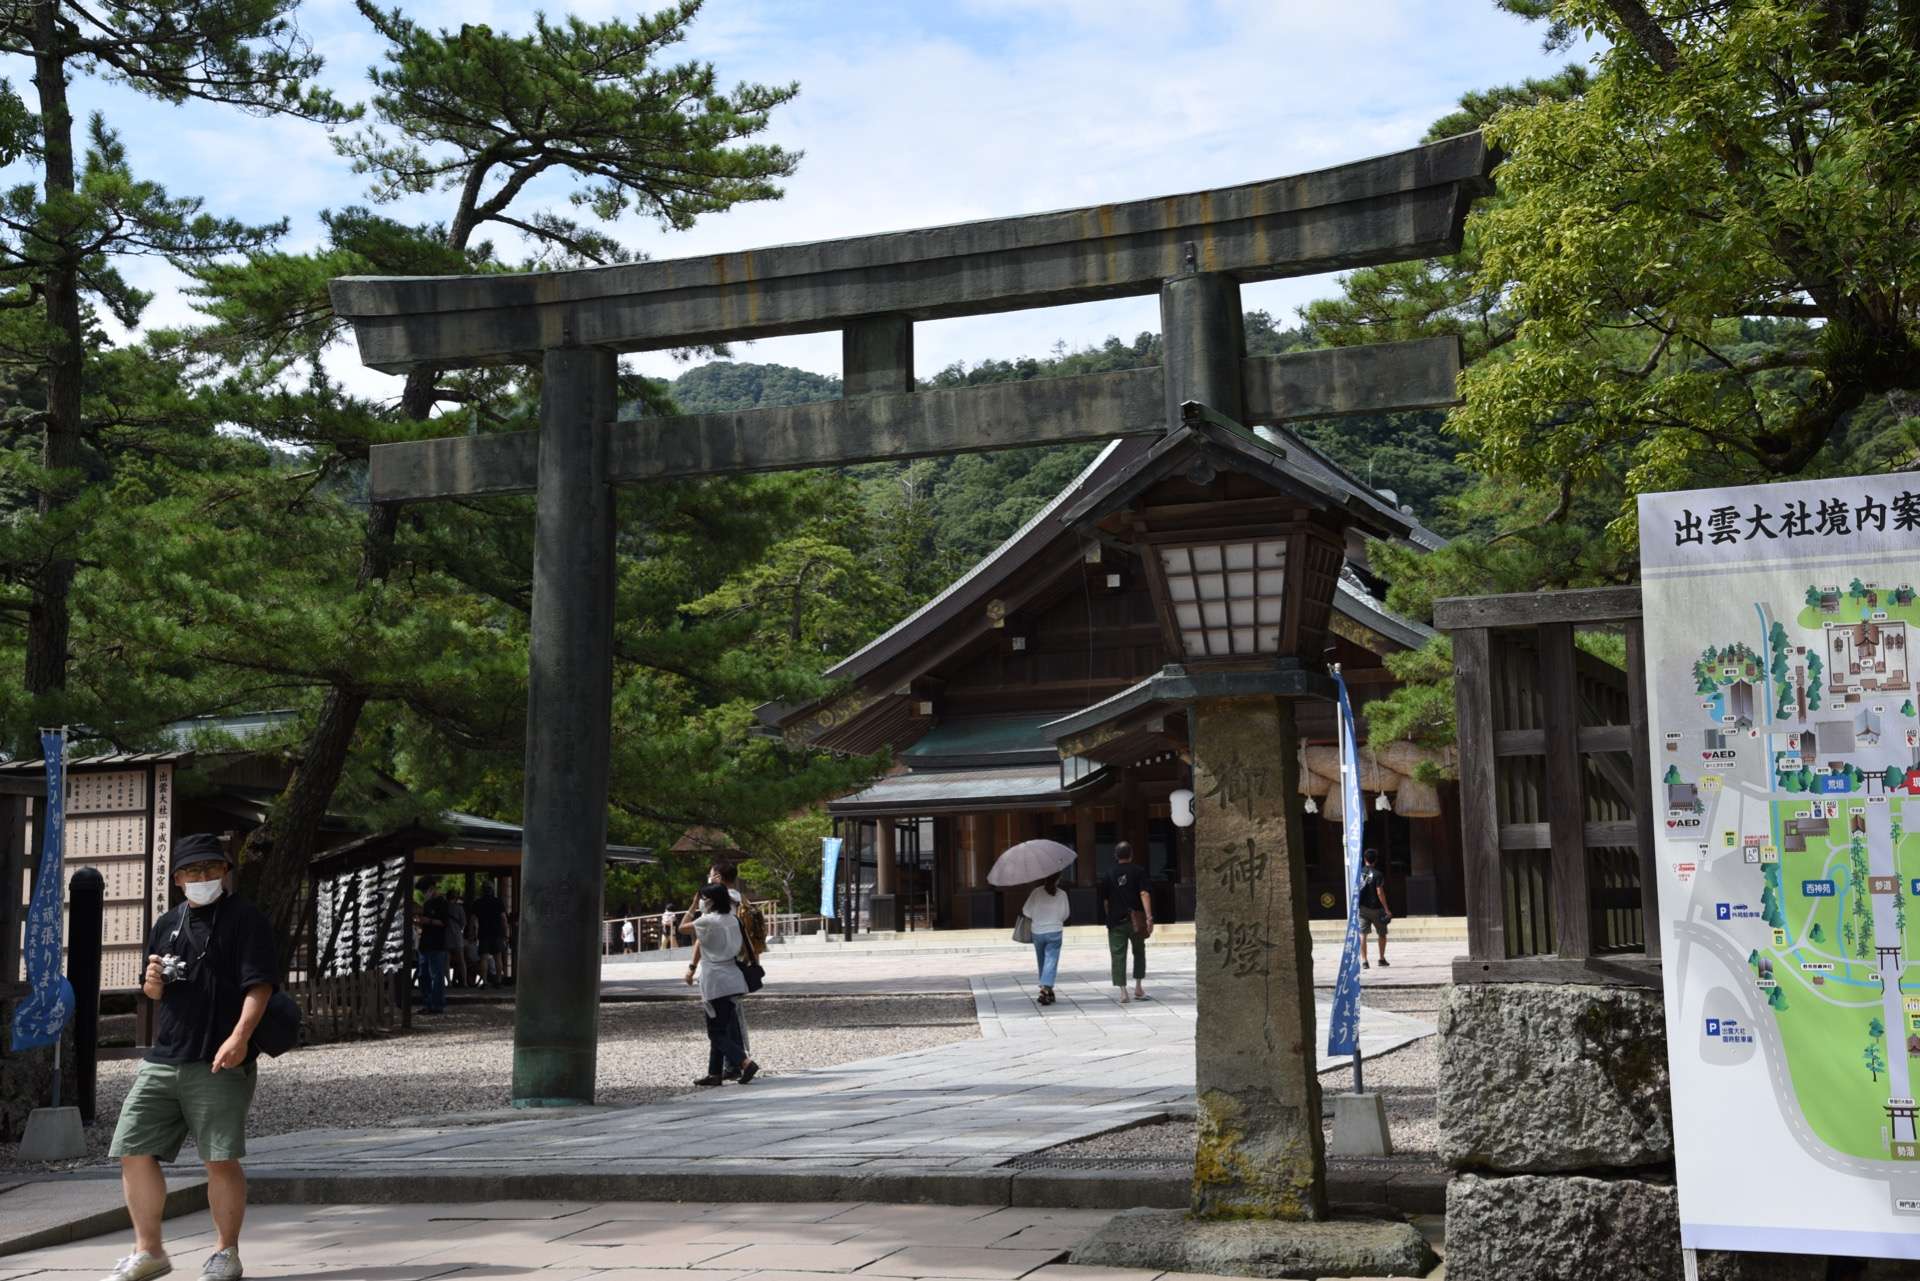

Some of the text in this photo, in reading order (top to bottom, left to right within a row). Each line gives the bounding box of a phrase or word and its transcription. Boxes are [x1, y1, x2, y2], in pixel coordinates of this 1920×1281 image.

[1674, 491, 1920, 546] 出雲大社境内案
[1712, 751, 1736, 759] AED
[1677, 819, 1700, 827] AED
